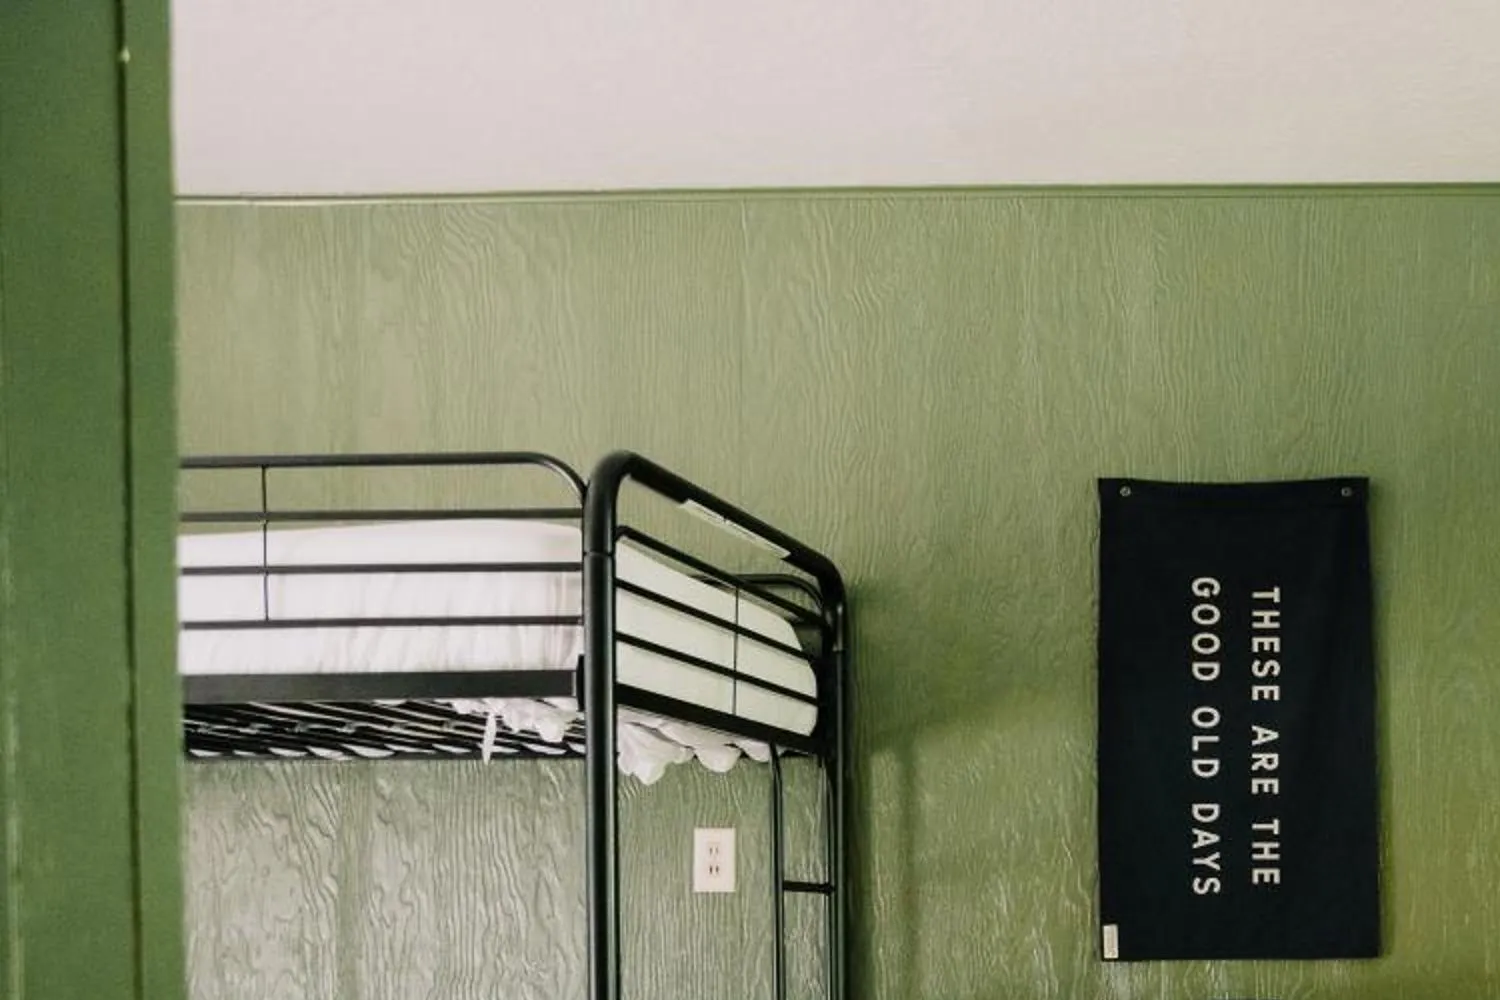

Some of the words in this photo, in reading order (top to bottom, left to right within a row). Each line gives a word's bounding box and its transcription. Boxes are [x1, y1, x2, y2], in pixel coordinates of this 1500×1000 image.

[1191, 577, 1221, 681] GOOD
[1251, 586, 1281, 701] THESE
[1191, 706, 1221, 778] OLD
[1251, 724, 1280, 795] ARE
[1191, 803, 1221, 895] DAYS
[1251, 818, 1281, 885] THE
